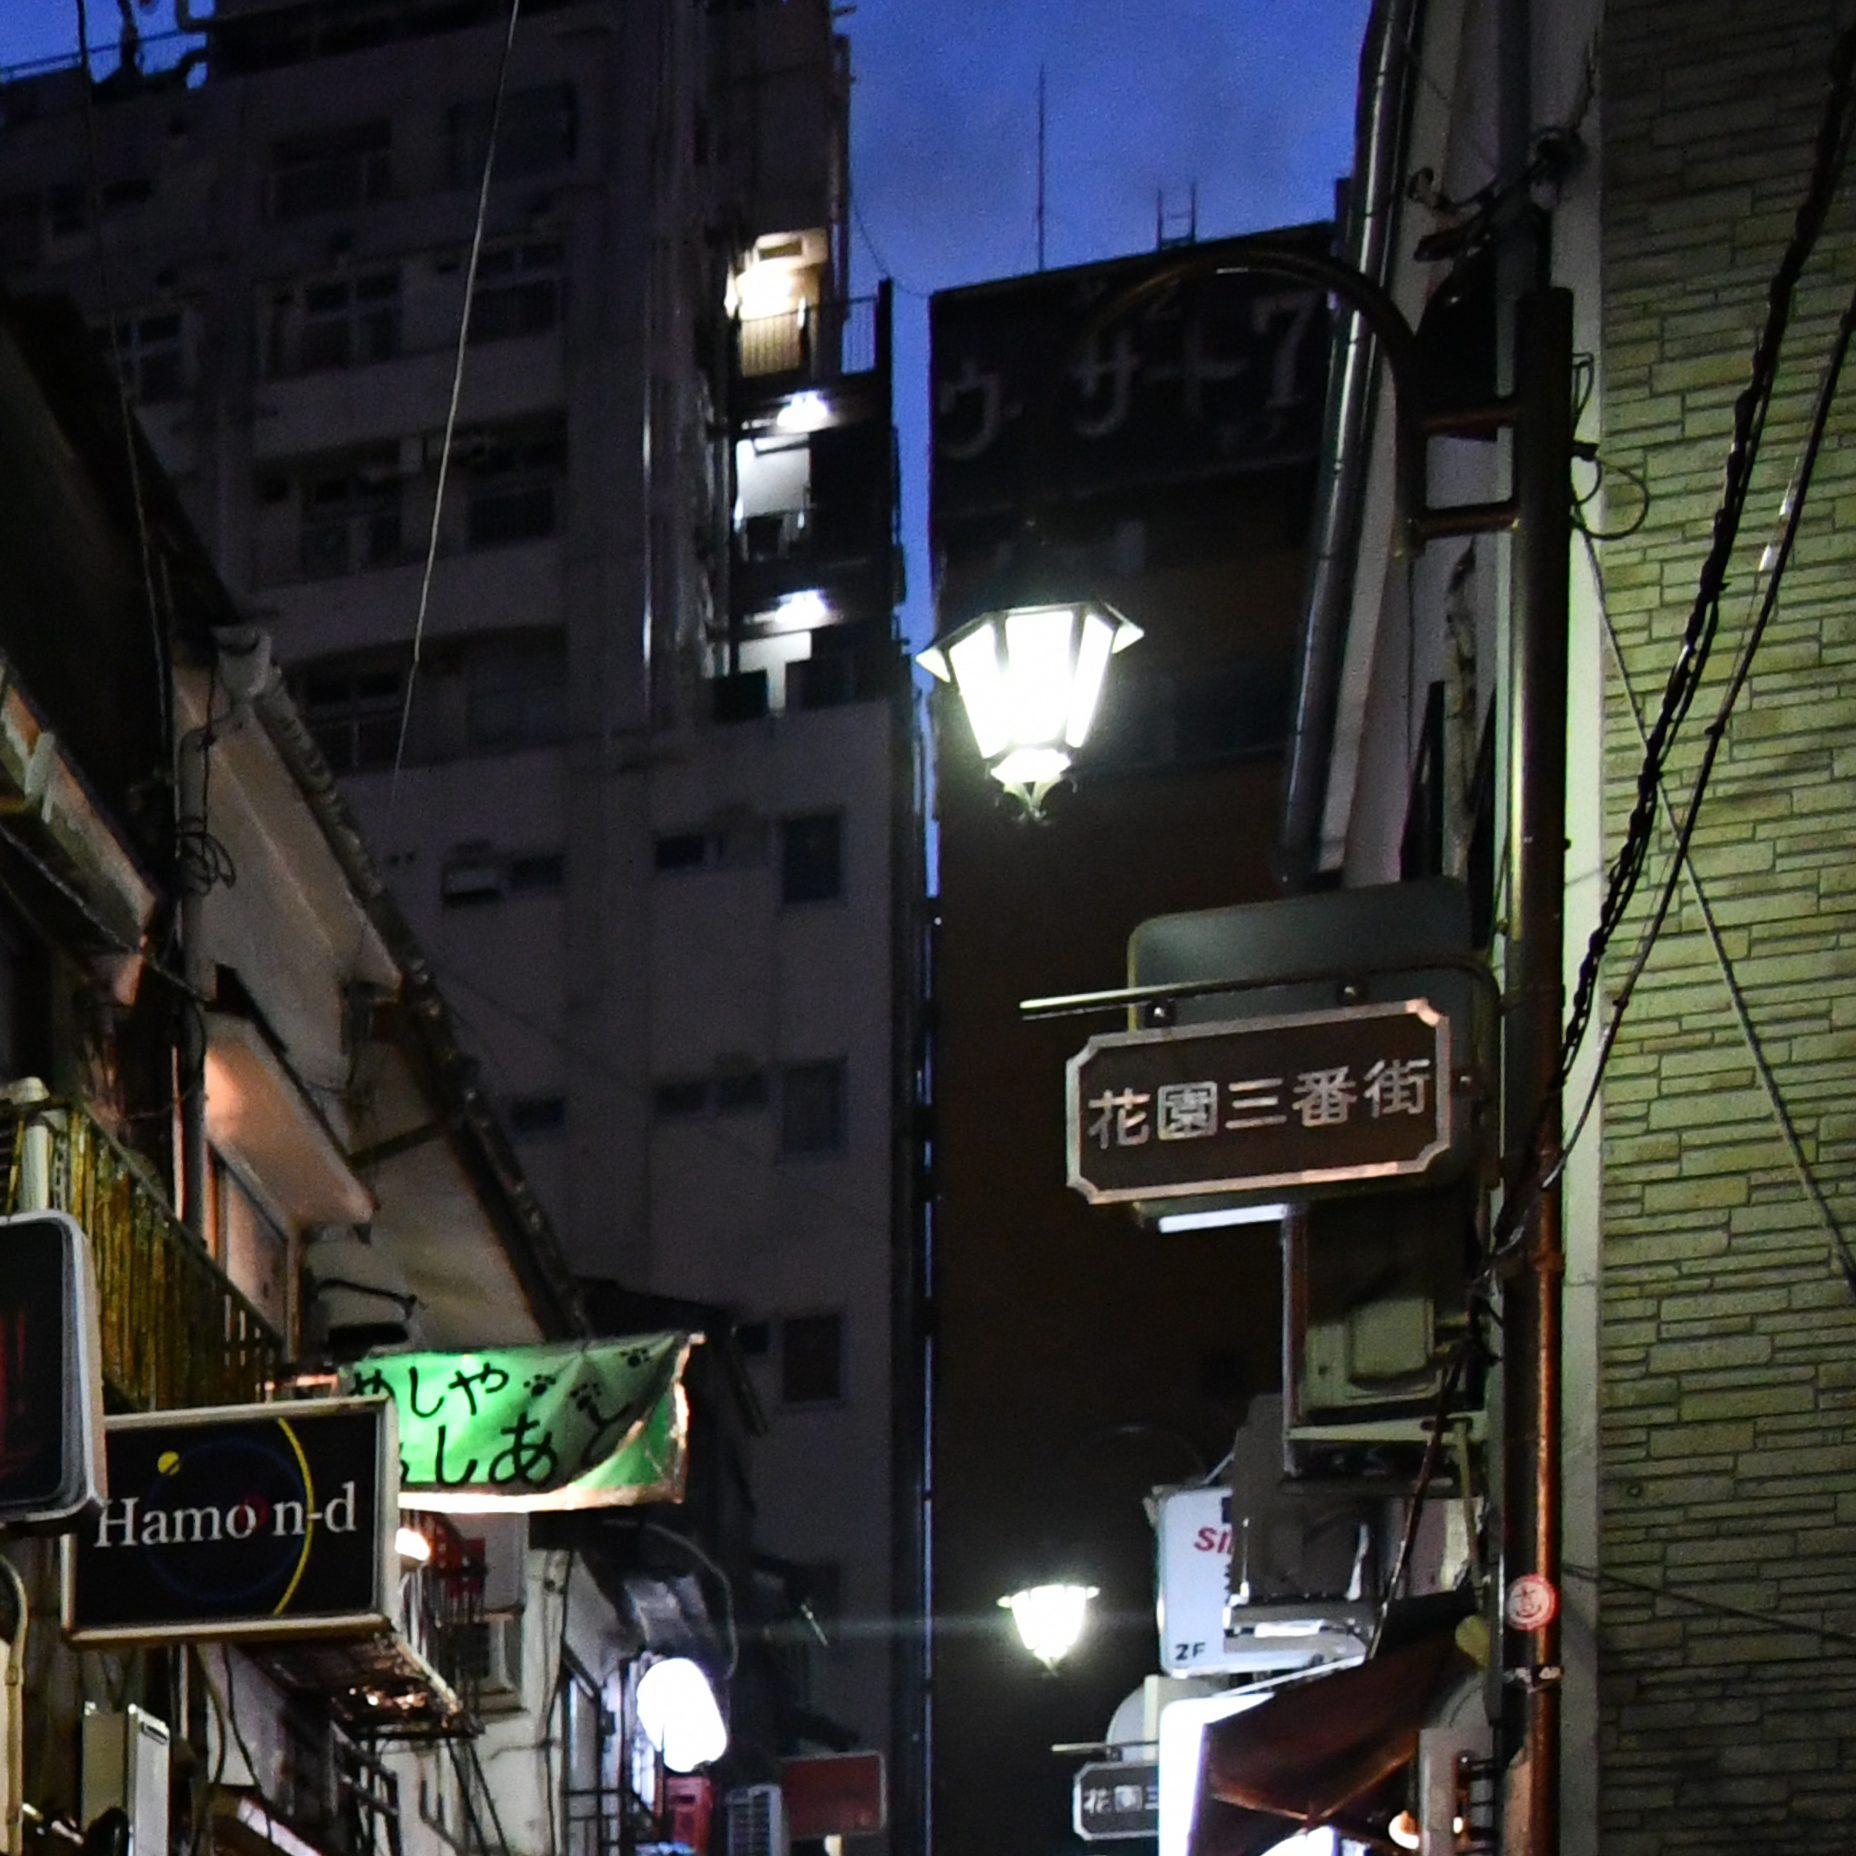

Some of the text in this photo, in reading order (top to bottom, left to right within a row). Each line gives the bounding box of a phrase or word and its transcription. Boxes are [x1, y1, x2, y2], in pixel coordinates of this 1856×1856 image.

[1088, 1059, 1431, 1149] 花園三番街
[1194, 1526, 1233, 1555] SI
